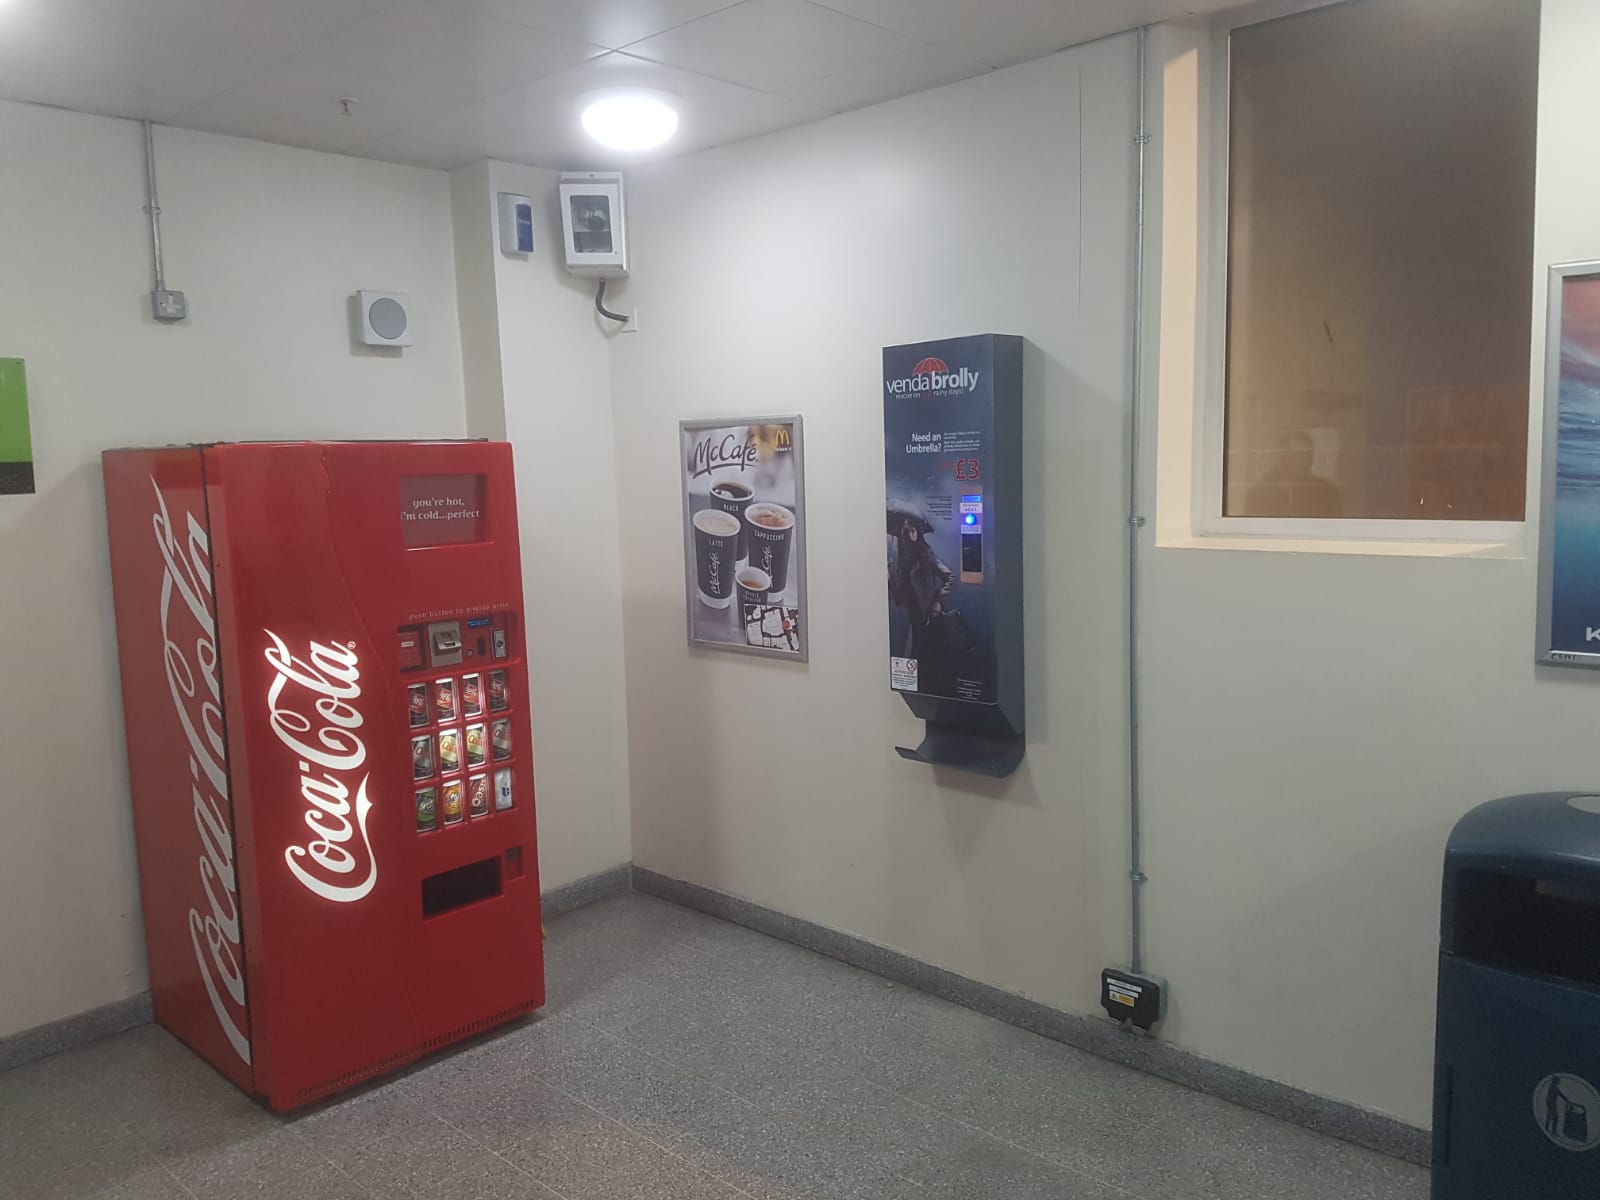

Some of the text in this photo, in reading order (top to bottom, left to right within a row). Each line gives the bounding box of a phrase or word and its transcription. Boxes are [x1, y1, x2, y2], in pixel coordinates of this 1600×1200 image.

[912, 432, 930, 442] Need
[932, 432, 942, 442] an
[906, 444, 942, 454] Umbrella?
[954, 459, 980, 480] £3
[412, 497, 444, 509] you're
